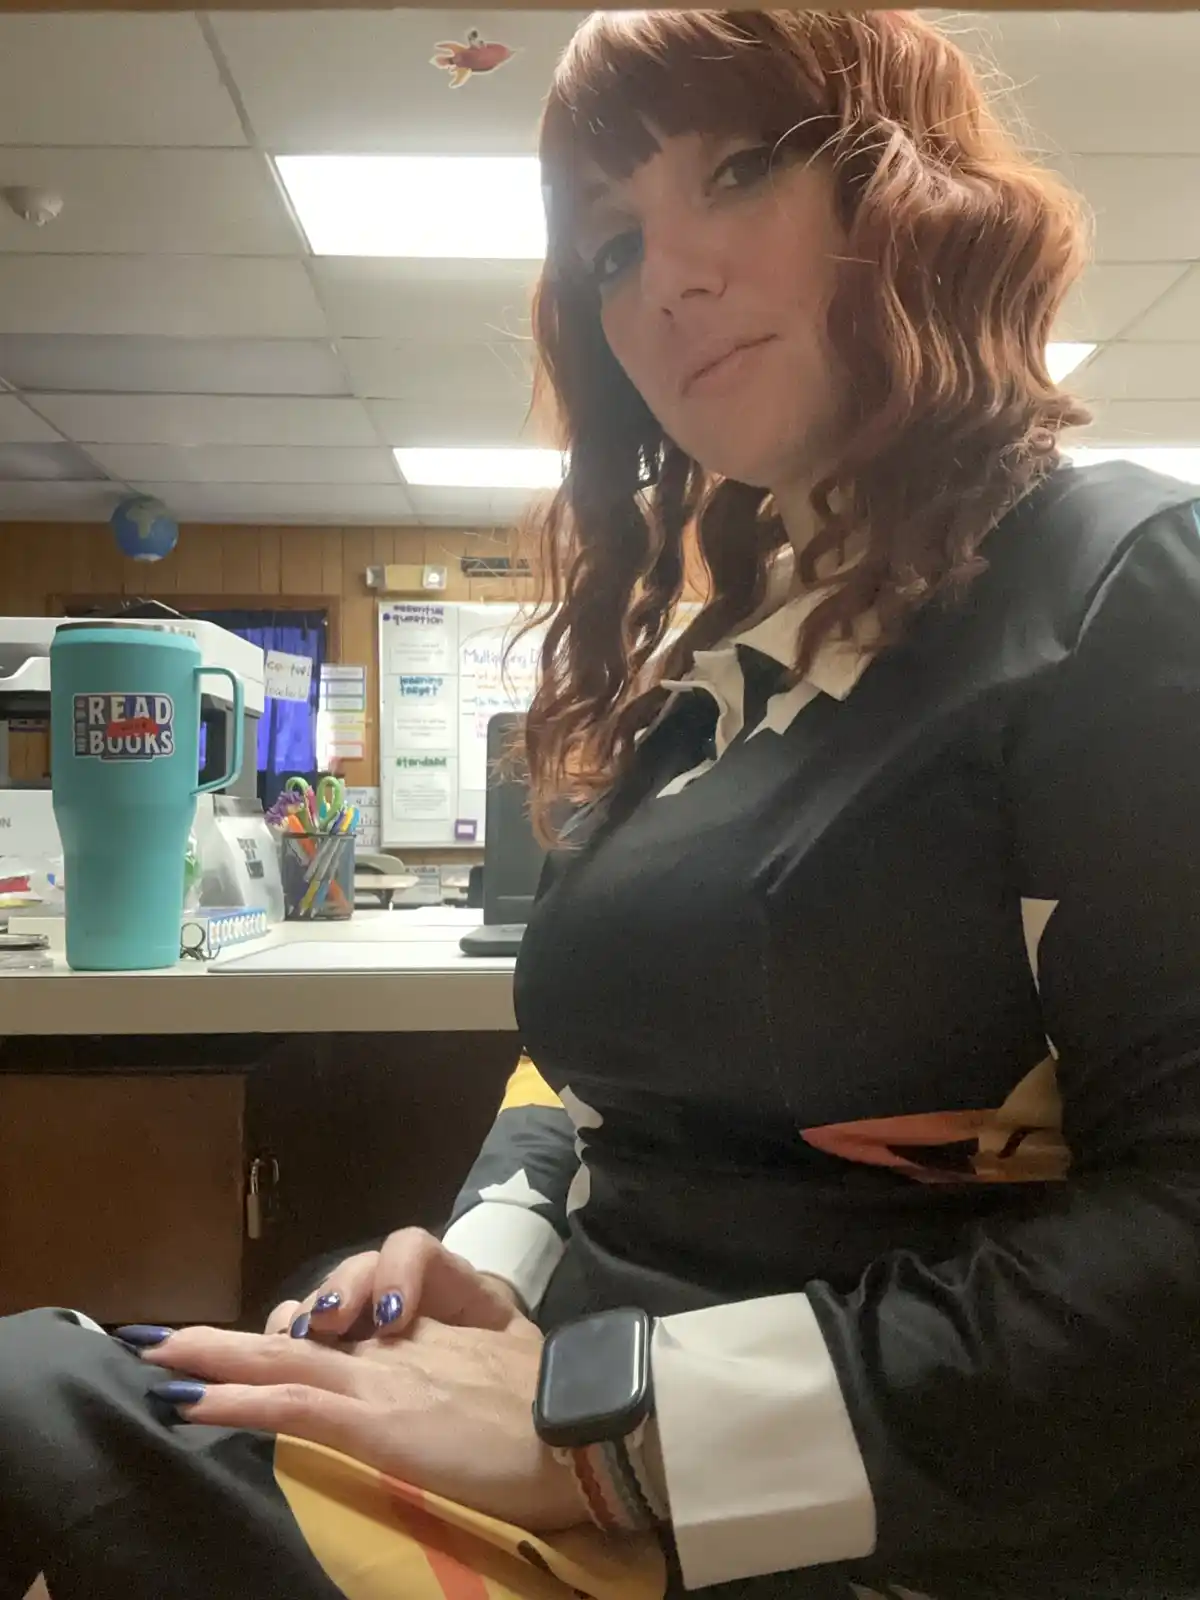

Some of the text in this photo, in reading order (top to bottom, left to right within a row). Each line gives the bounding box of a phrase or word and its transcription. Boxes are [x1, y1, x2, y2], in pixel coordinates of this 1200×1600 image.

[392, 614, 444, 626] question
[464, 648, 527, 668] Multipying
[399, 675, 443, 686] learning
[400, 684, 439, 697] target
[88, 696, 172, 725] READ
[88, 731, 173, 754] BOOKS
[396, 756, 447, 768] standard
